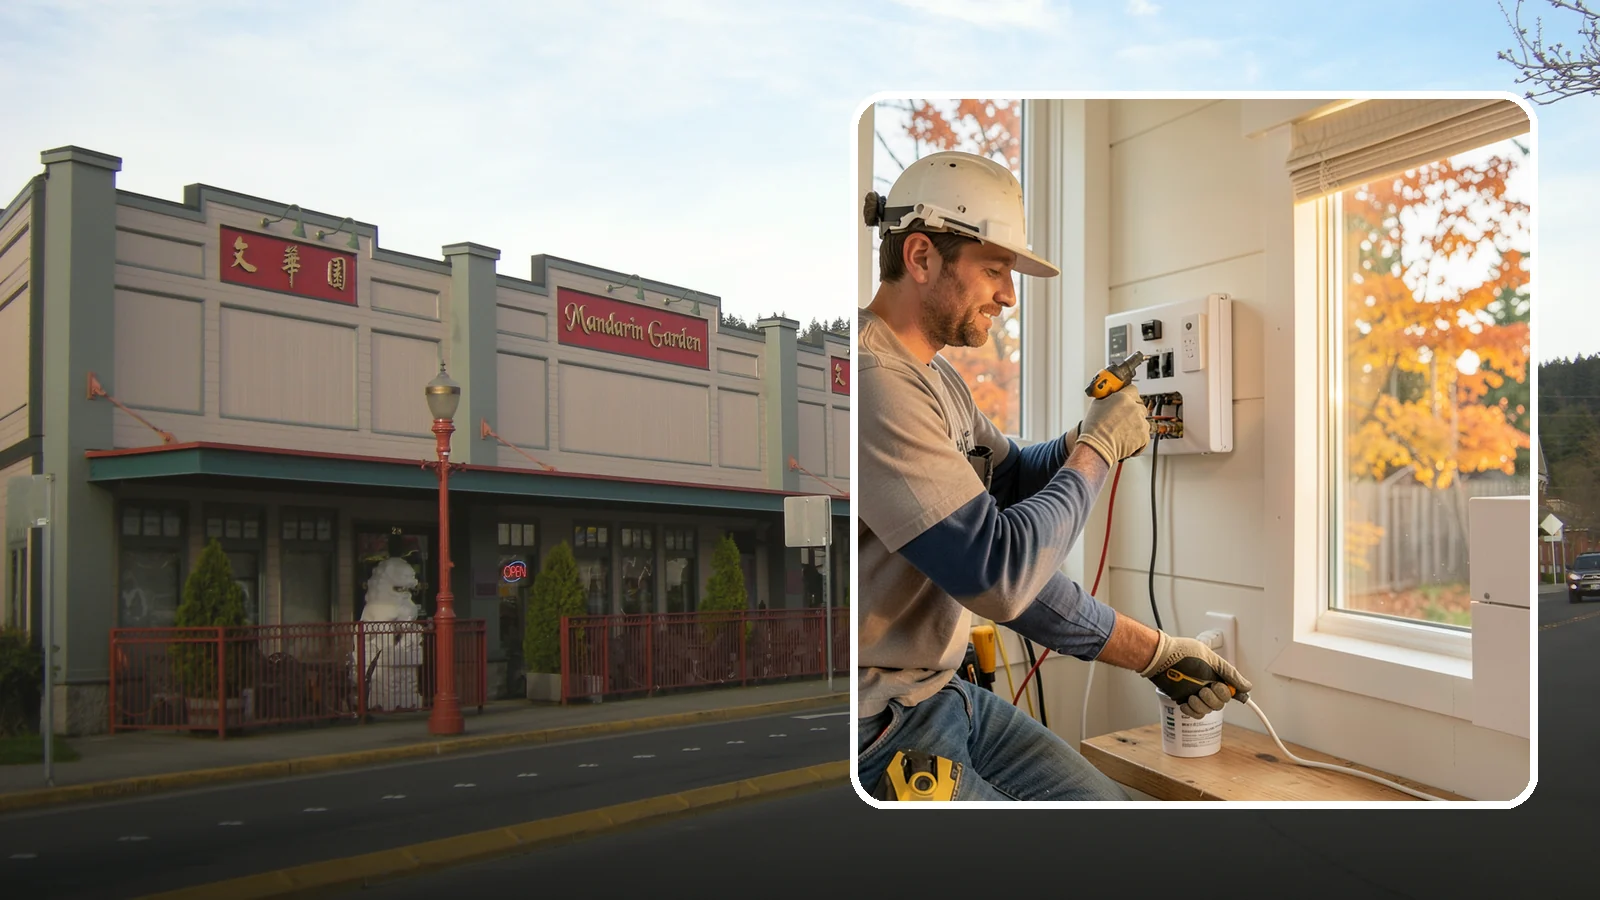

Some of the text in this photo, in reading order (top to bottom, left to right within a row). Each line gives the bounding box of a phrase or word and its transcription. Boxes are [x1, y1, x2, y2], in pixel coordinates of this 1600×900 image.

[231, 236, 346, 291] 文華園
[564, 302, 701, 352] Mandarin Garden
[503, 565, 526, 578] OPEN
